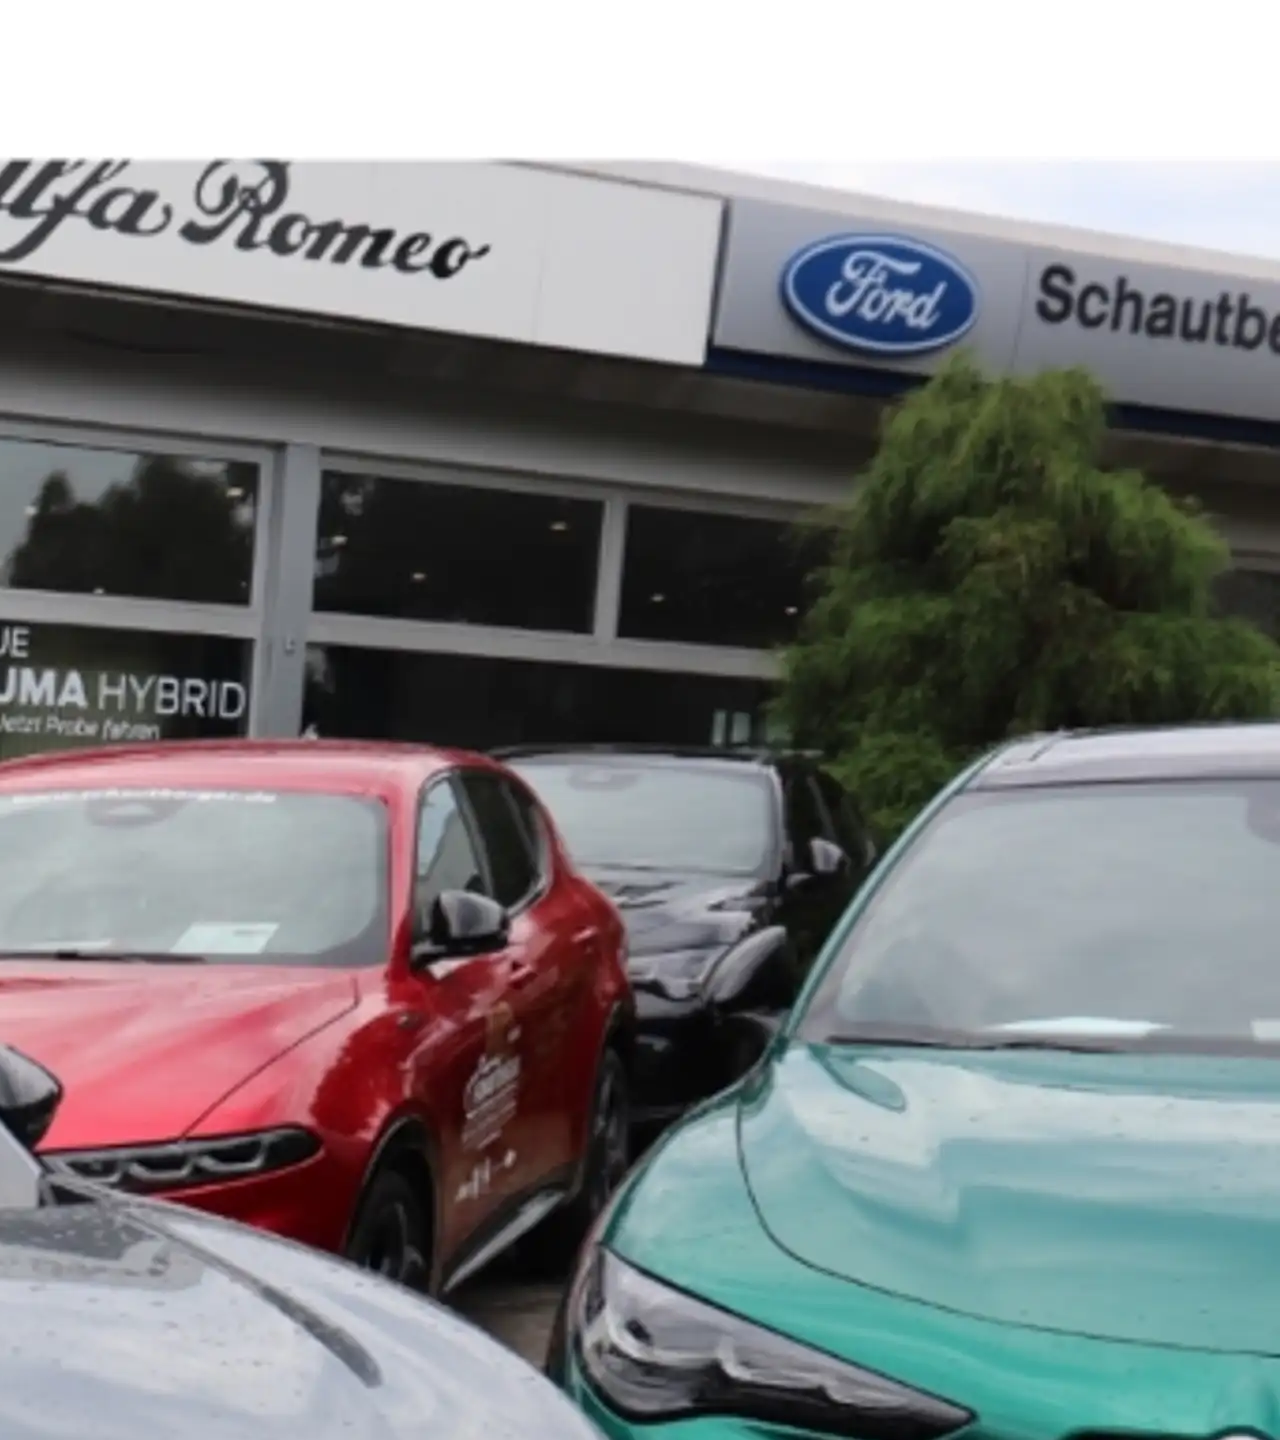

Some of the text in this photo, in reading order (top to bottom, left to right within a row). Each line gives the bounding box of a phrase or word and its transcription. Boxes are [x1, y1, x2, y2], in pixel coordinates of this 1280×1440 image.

[178, 160, 490, 280] Romeo
[824, 250, 947, 331] Ford
[97, 673, 246, 719] HYBRID
